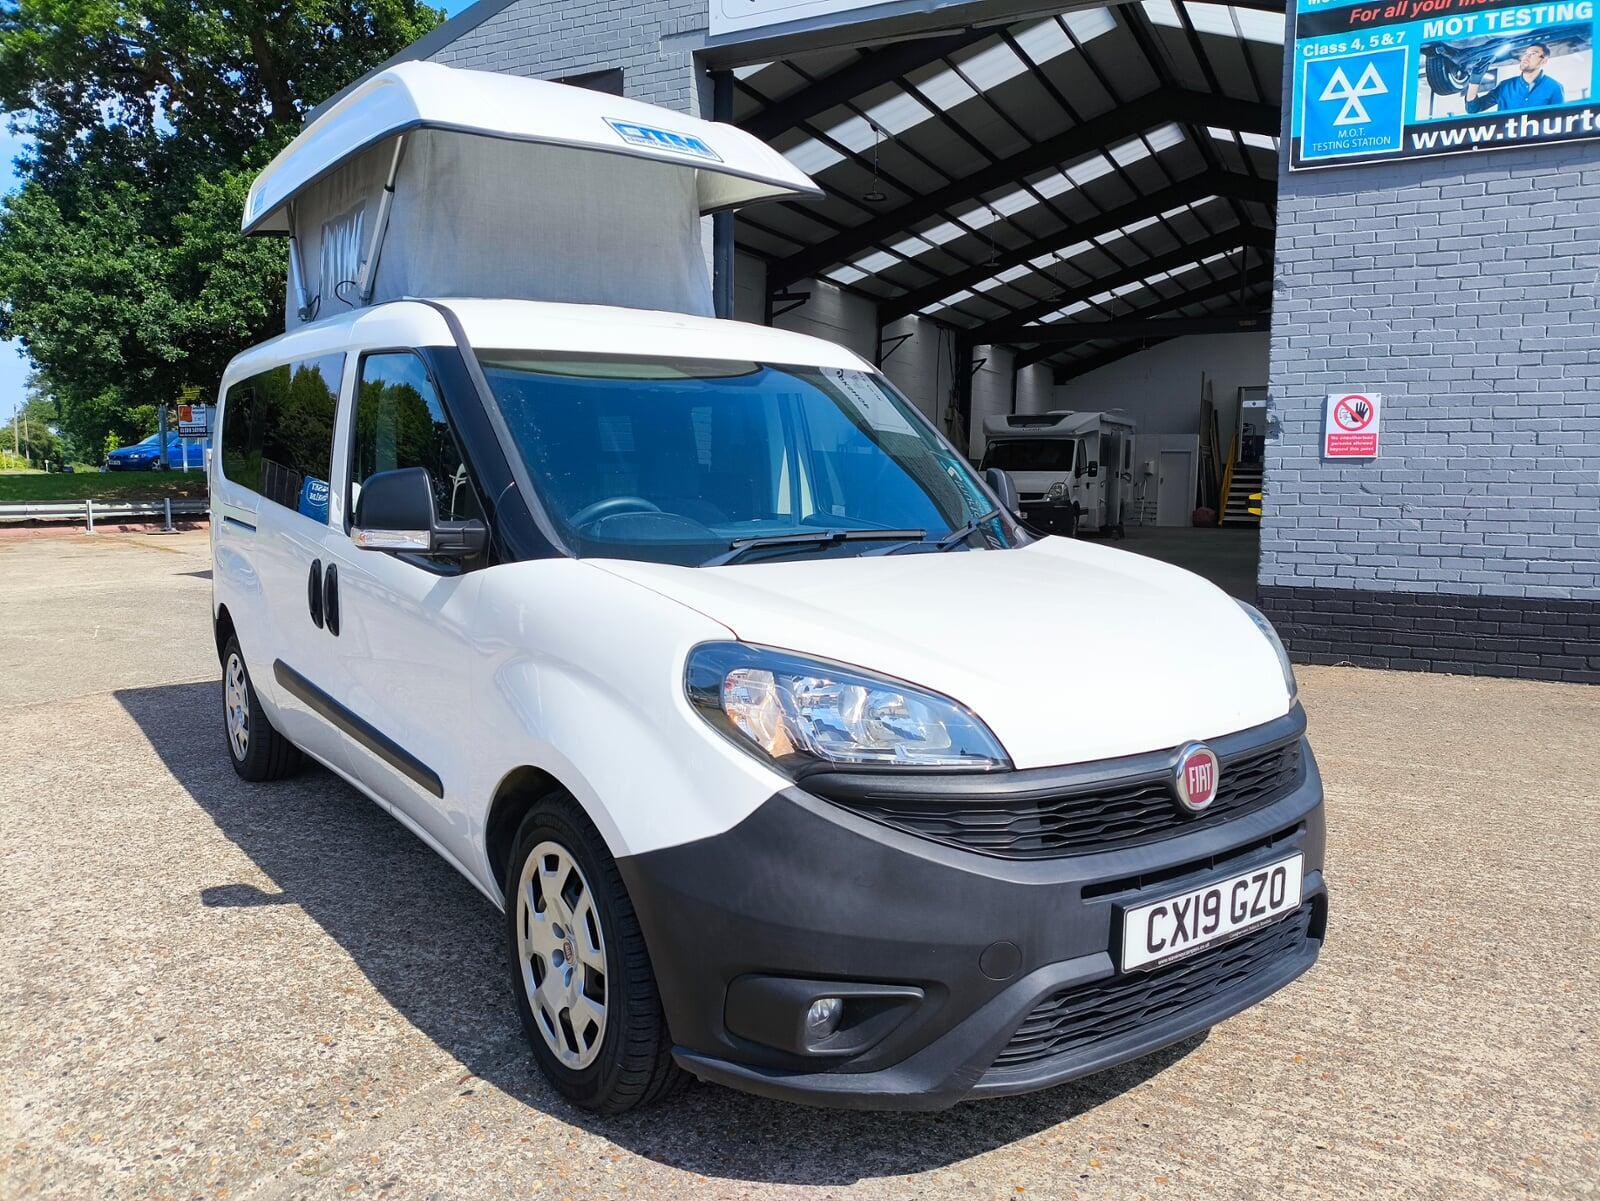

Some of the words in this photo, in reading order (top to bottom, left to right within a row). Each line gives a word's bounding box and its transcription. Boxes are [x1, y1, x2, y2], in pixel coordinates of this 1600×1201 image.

[1349, 7, 1382, 24] For
[1384, 0, 1409, 18] all
[1409, 0, 1452, 18] your
[1423, 15, 1478, 39] MOT
[1485, 1, 1593, 30] TESTING
[1303, 42, 1347, 57] Class
[1350, 38, 1365, 51] 4,
[1312, 139, 1350, 152] TESTING
[1351, 136, 1391, 148] STATION
[1338, 127, 1366, 138] M.O.T.
[1412, 110, 1600, 150] www.thurt
[1188, 763, 1212, 795] FIAT
[1147, 888, 1221, 954] CX19
[1230, 866, 1286, 925] GZO
